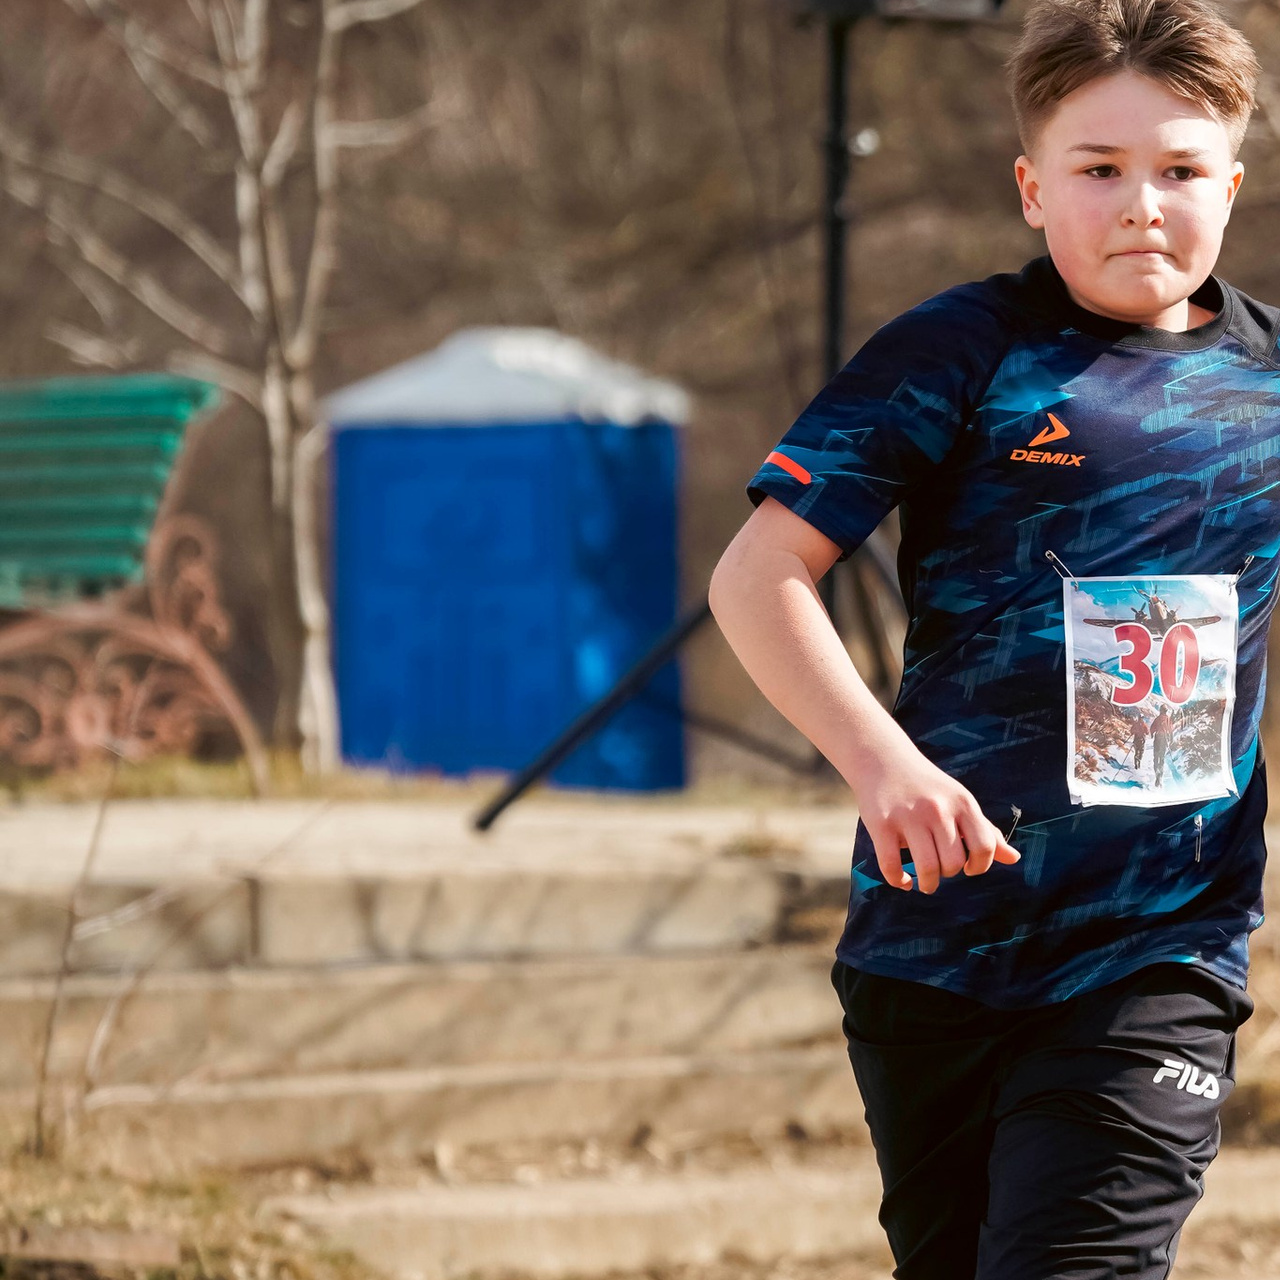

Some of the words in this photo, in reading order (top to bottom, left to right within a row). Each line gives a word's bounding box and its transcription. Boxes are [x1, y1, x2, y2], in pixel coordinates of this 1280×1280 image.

[1010, 449, 1086, 467] DEMIX
[1111, 623, 1200, 706] 30
[1152, 1058, 1220, 1100] FILA
